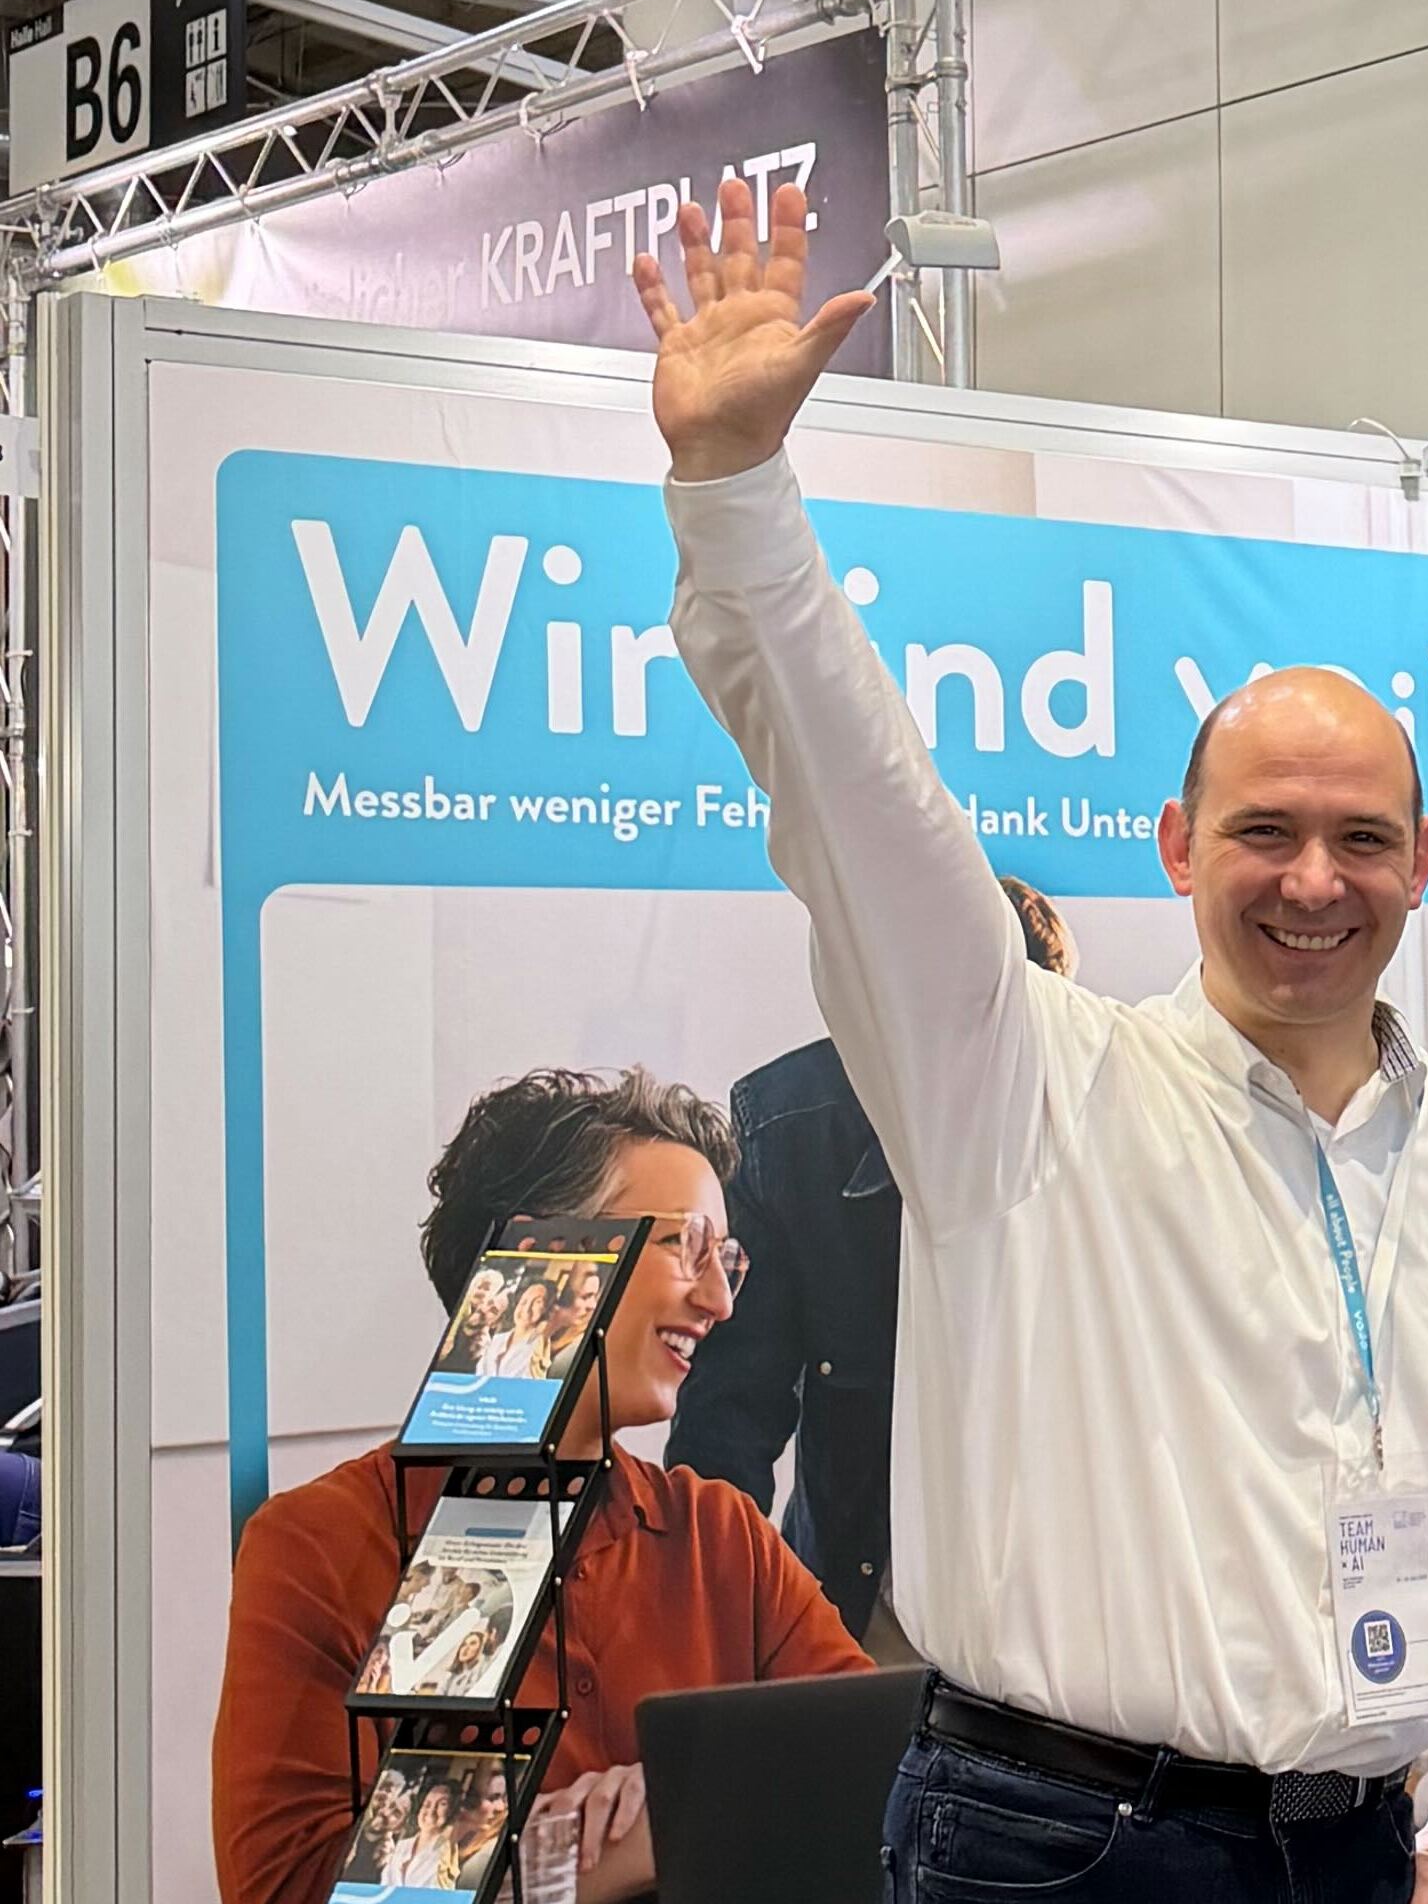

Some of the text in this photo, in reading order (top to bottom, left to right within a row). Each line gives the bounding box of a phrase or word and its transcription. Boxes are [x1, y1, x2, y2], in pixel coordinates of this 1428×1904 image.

[66, 21, 142, 162] B6
[290, 519, 681, 737] Wir
[303, 771, 497, 820] Messbar
[510, 783, 681, 841] weniger
[695, 784, 771, 828] Feh
[1339, 1250, 1358, 1294] People
[1339, 1520, 1374, 1537] TEAM
[1340, 1536, 1385, 1556] HUMAN
[1352, 1556, 1364, 1571] AI
